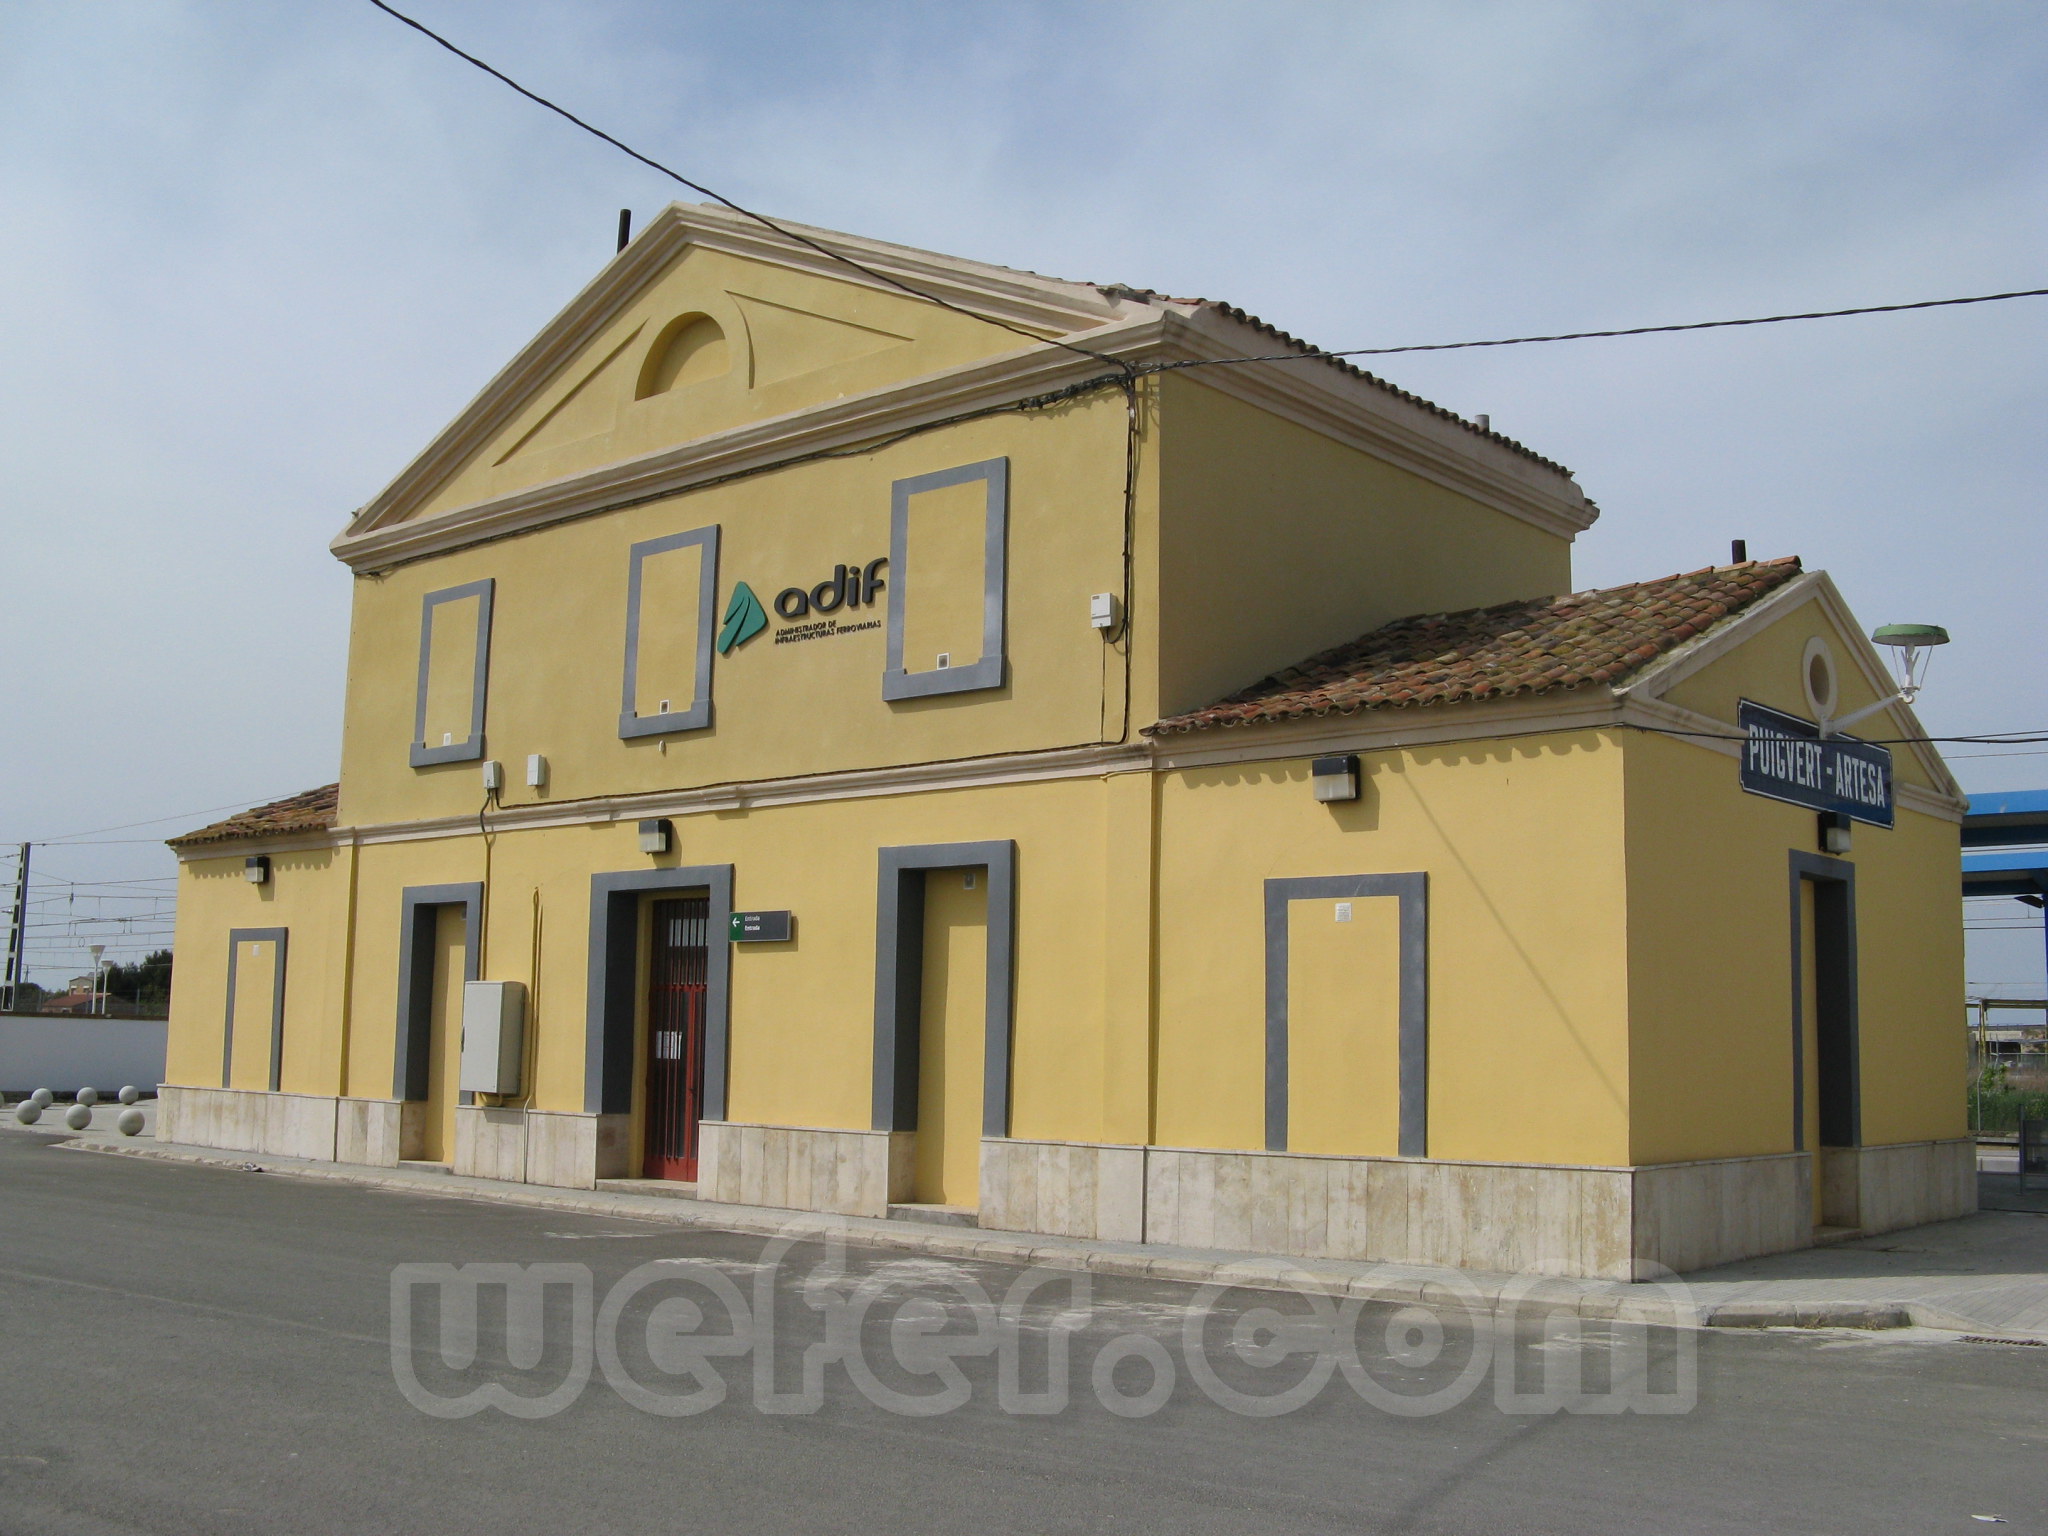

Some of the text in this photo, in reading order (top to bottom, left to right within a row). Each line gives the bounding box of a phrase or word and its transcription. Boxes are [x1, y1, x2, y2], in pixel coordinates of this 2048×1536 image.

[774, 557, 888, 618] adif
[775, 620, 882, 645] INFRAESTRUCTURAS FERROVIARIAS
[776, 620, 837, 637] ADMINISTRADOR DE
[1749, 723, 1822, 790] PUIGVERT
[1835, 752, 1886, 808] ARTESA
